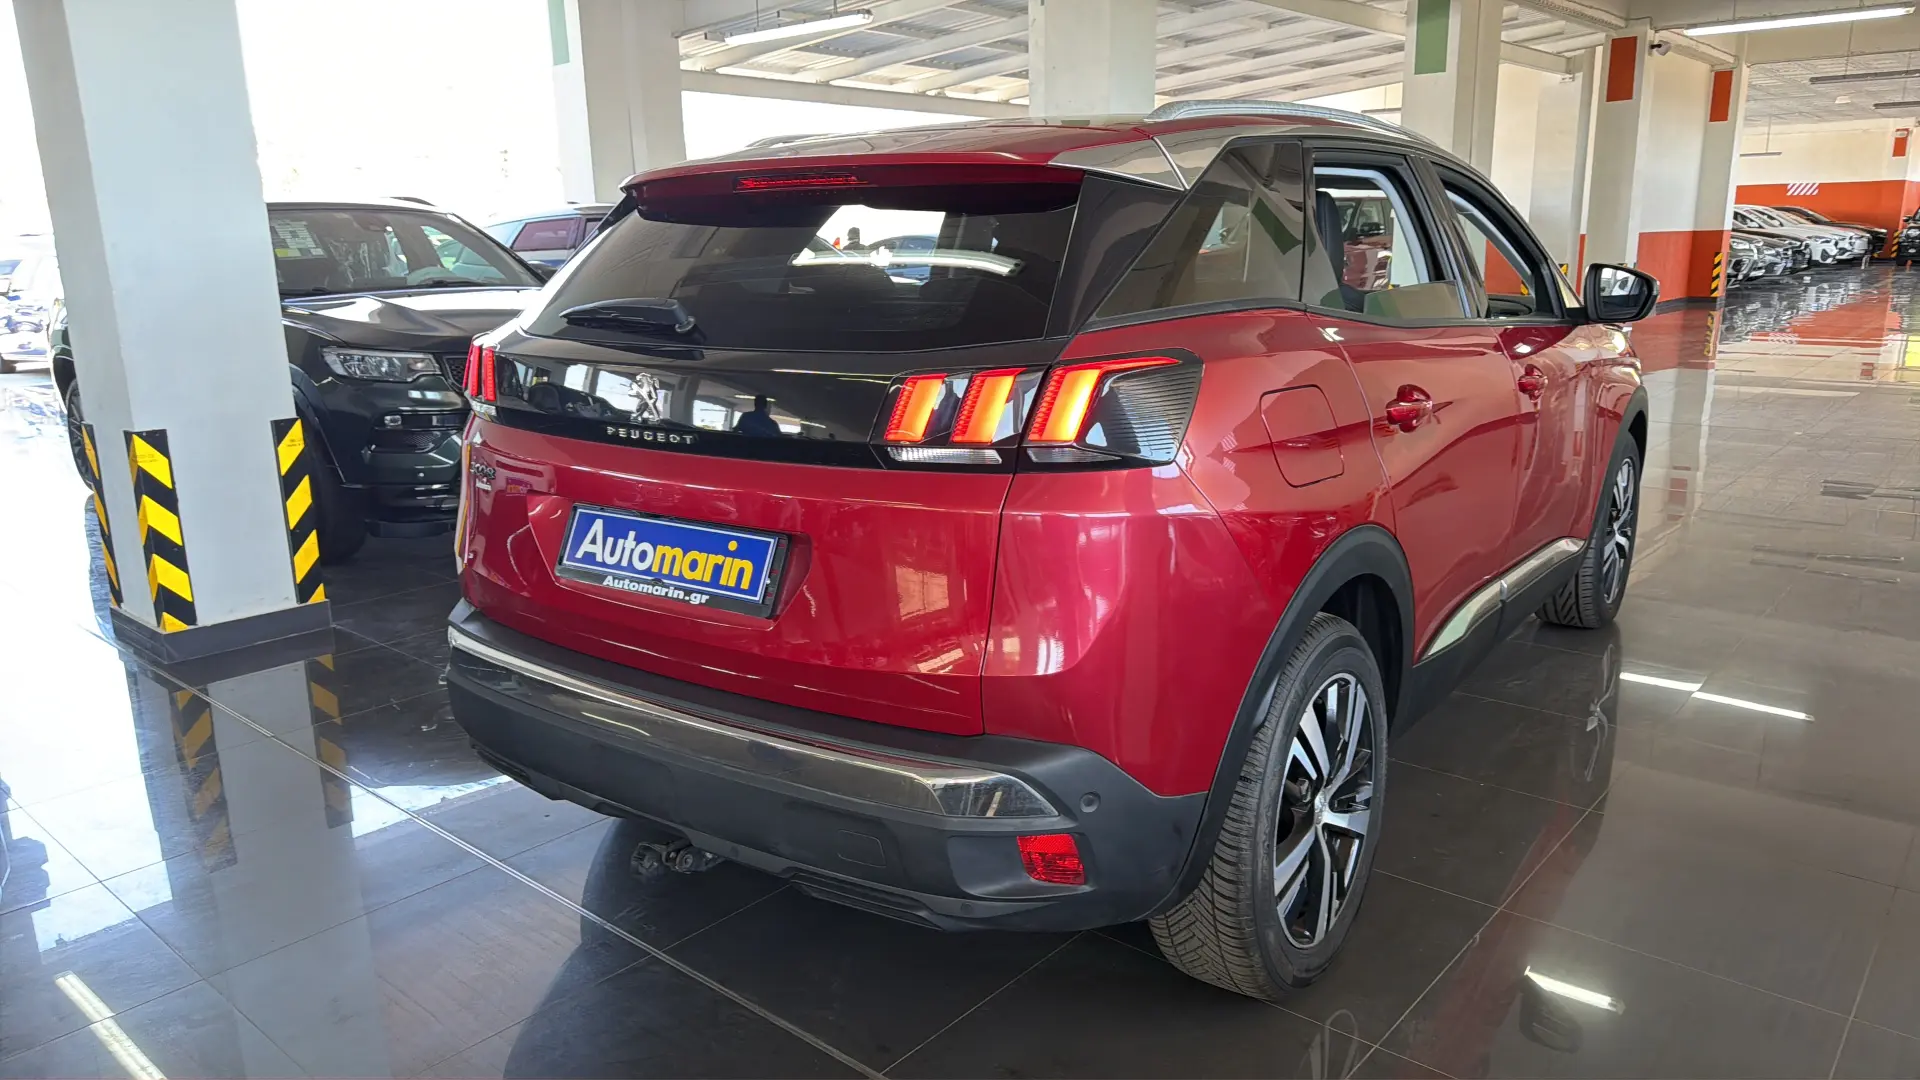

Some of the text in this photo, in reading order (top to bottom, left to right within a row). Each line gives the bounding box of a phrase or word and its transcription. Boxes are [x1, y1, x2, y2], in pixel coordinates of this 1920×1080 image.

[606, 426, 693, 445] PEUGEOT
[574, 518, 754, 590] Automarin
[602, 575, 709, 605] Automarin.gr
